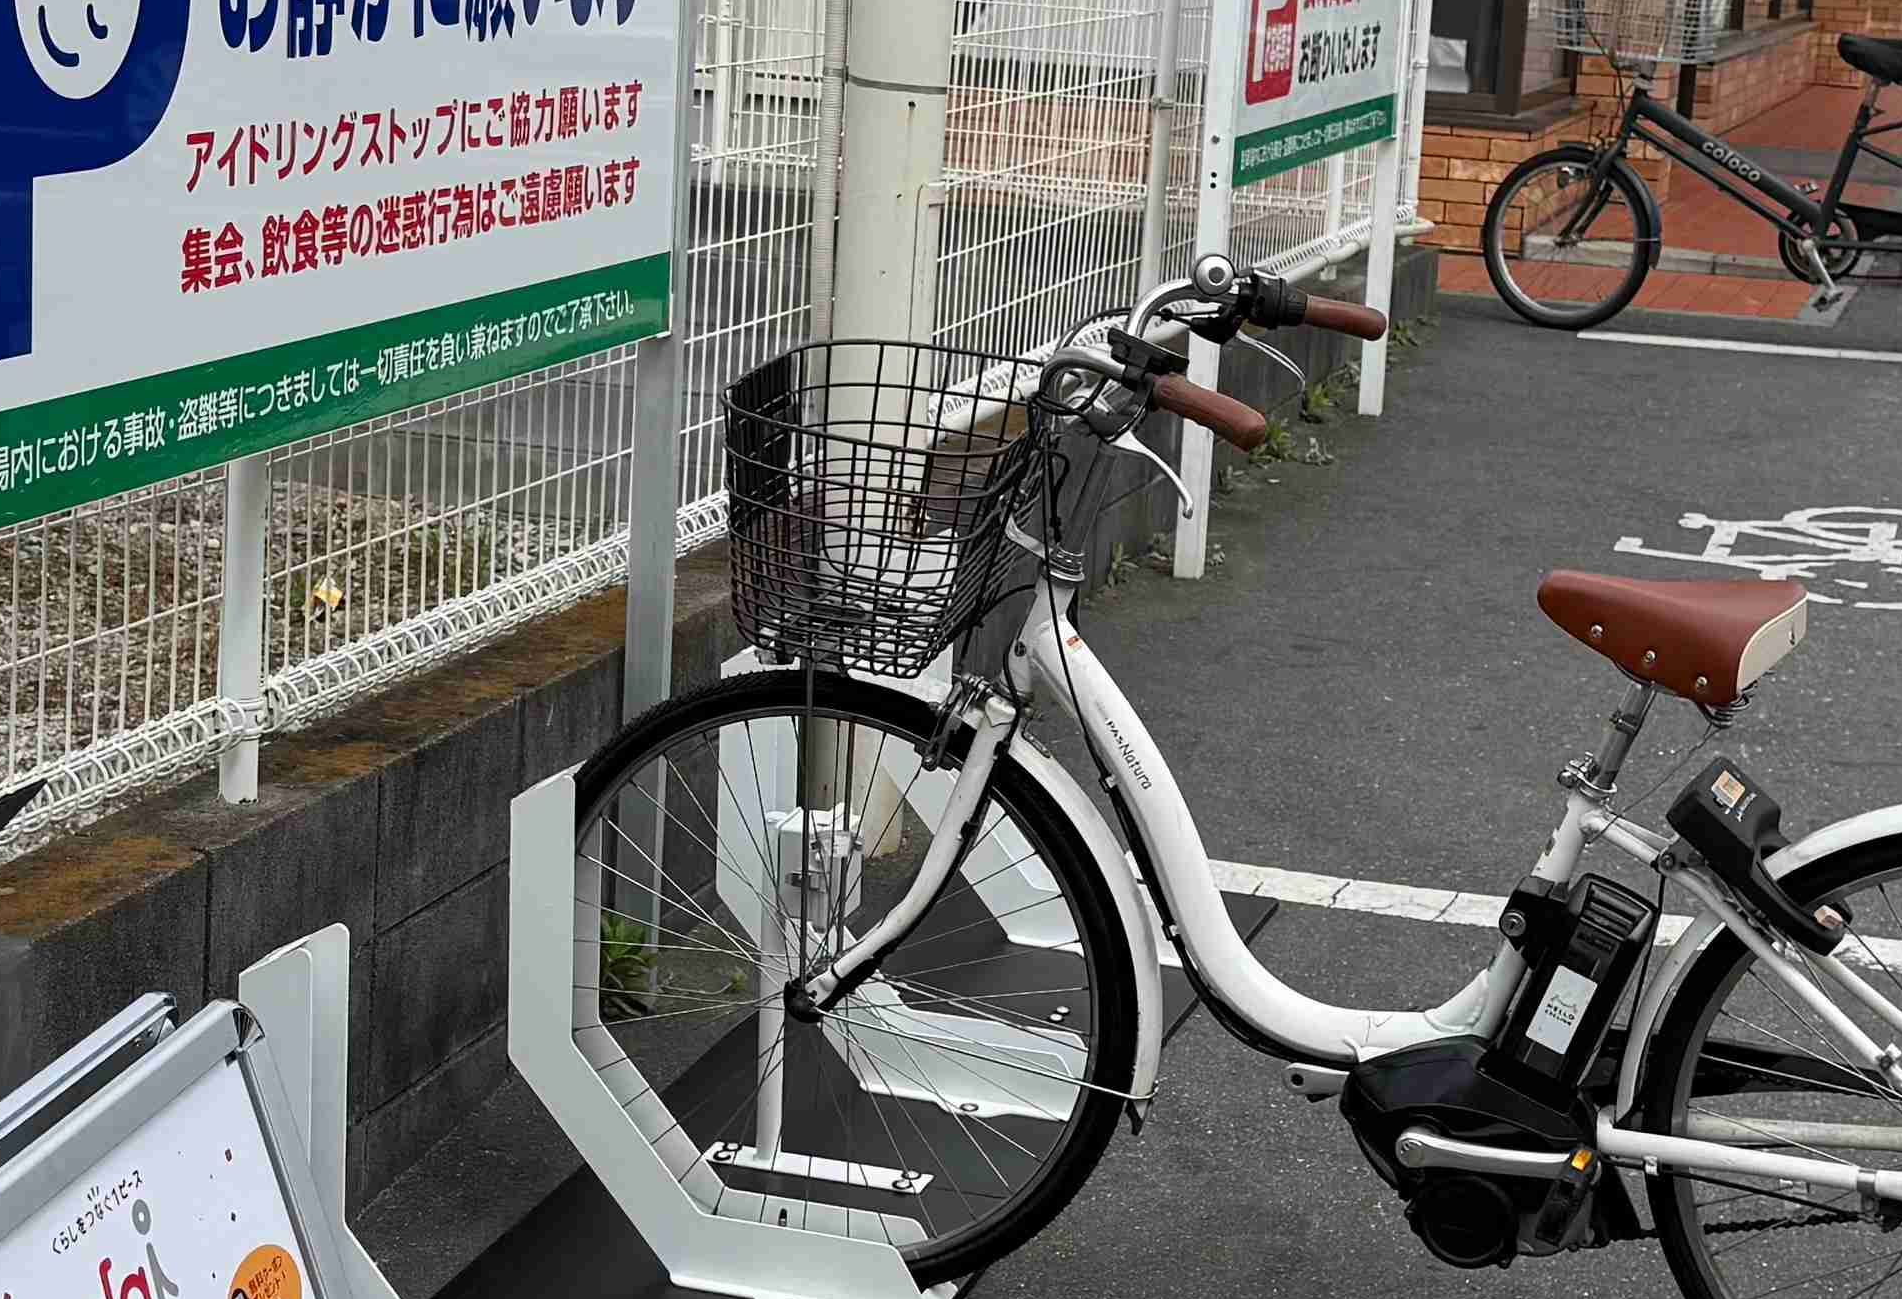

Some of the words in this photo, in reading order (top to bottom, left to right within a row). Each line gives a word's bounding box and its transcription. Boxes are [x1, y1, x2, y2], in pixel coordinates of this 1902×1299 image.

[1297, 20, 1381, 87] お断りいたします
[184, 80, 643, 194] アイドリングストップにご協力願います
[1702, 142, 1761, 182] coloco
[180, 153, 640, 297] 集会、飲食等の迷惑行為はご遠慮願います
[1119, 743, 1152, 790] Natura
